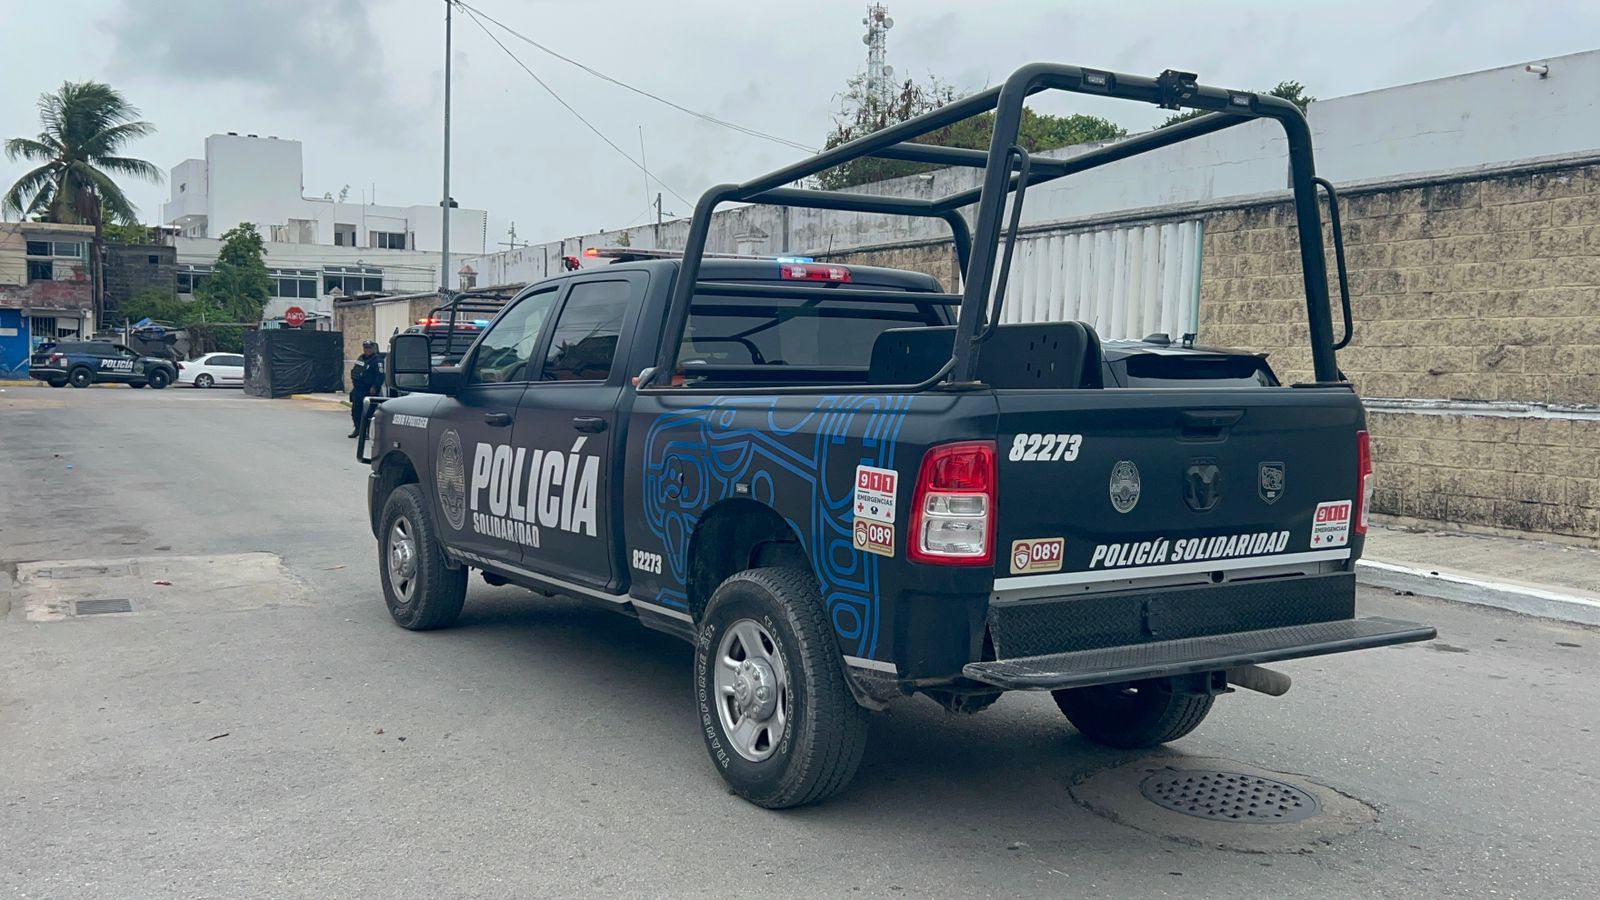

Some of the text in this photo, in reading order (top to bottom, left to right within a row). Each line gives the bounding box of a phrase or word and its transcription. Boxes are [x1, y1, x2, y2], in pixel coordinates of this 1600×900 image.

[101, 358, 134, 369] POLICÍA
[1008, 433, 1083, 462] 82273
[470, 436, 600, 537] POLICÍA
[861, 473, 891, 491] 911
[857, 493, 893, 506] EMERGENCIAS
[1318, 506, 1347, 520] 911
[473, 512, 540, 548] SOLIDARIDAD
[869, 525, 892, 544] 089
[1314, 525, 1347, 533] EMERGENCIAS
[1032, 543, 1060, 560] 089
[1089, 530, 1290, 568] POLICÍA SOLIDARIDAD
[632, 549, 662, 575] 82273
